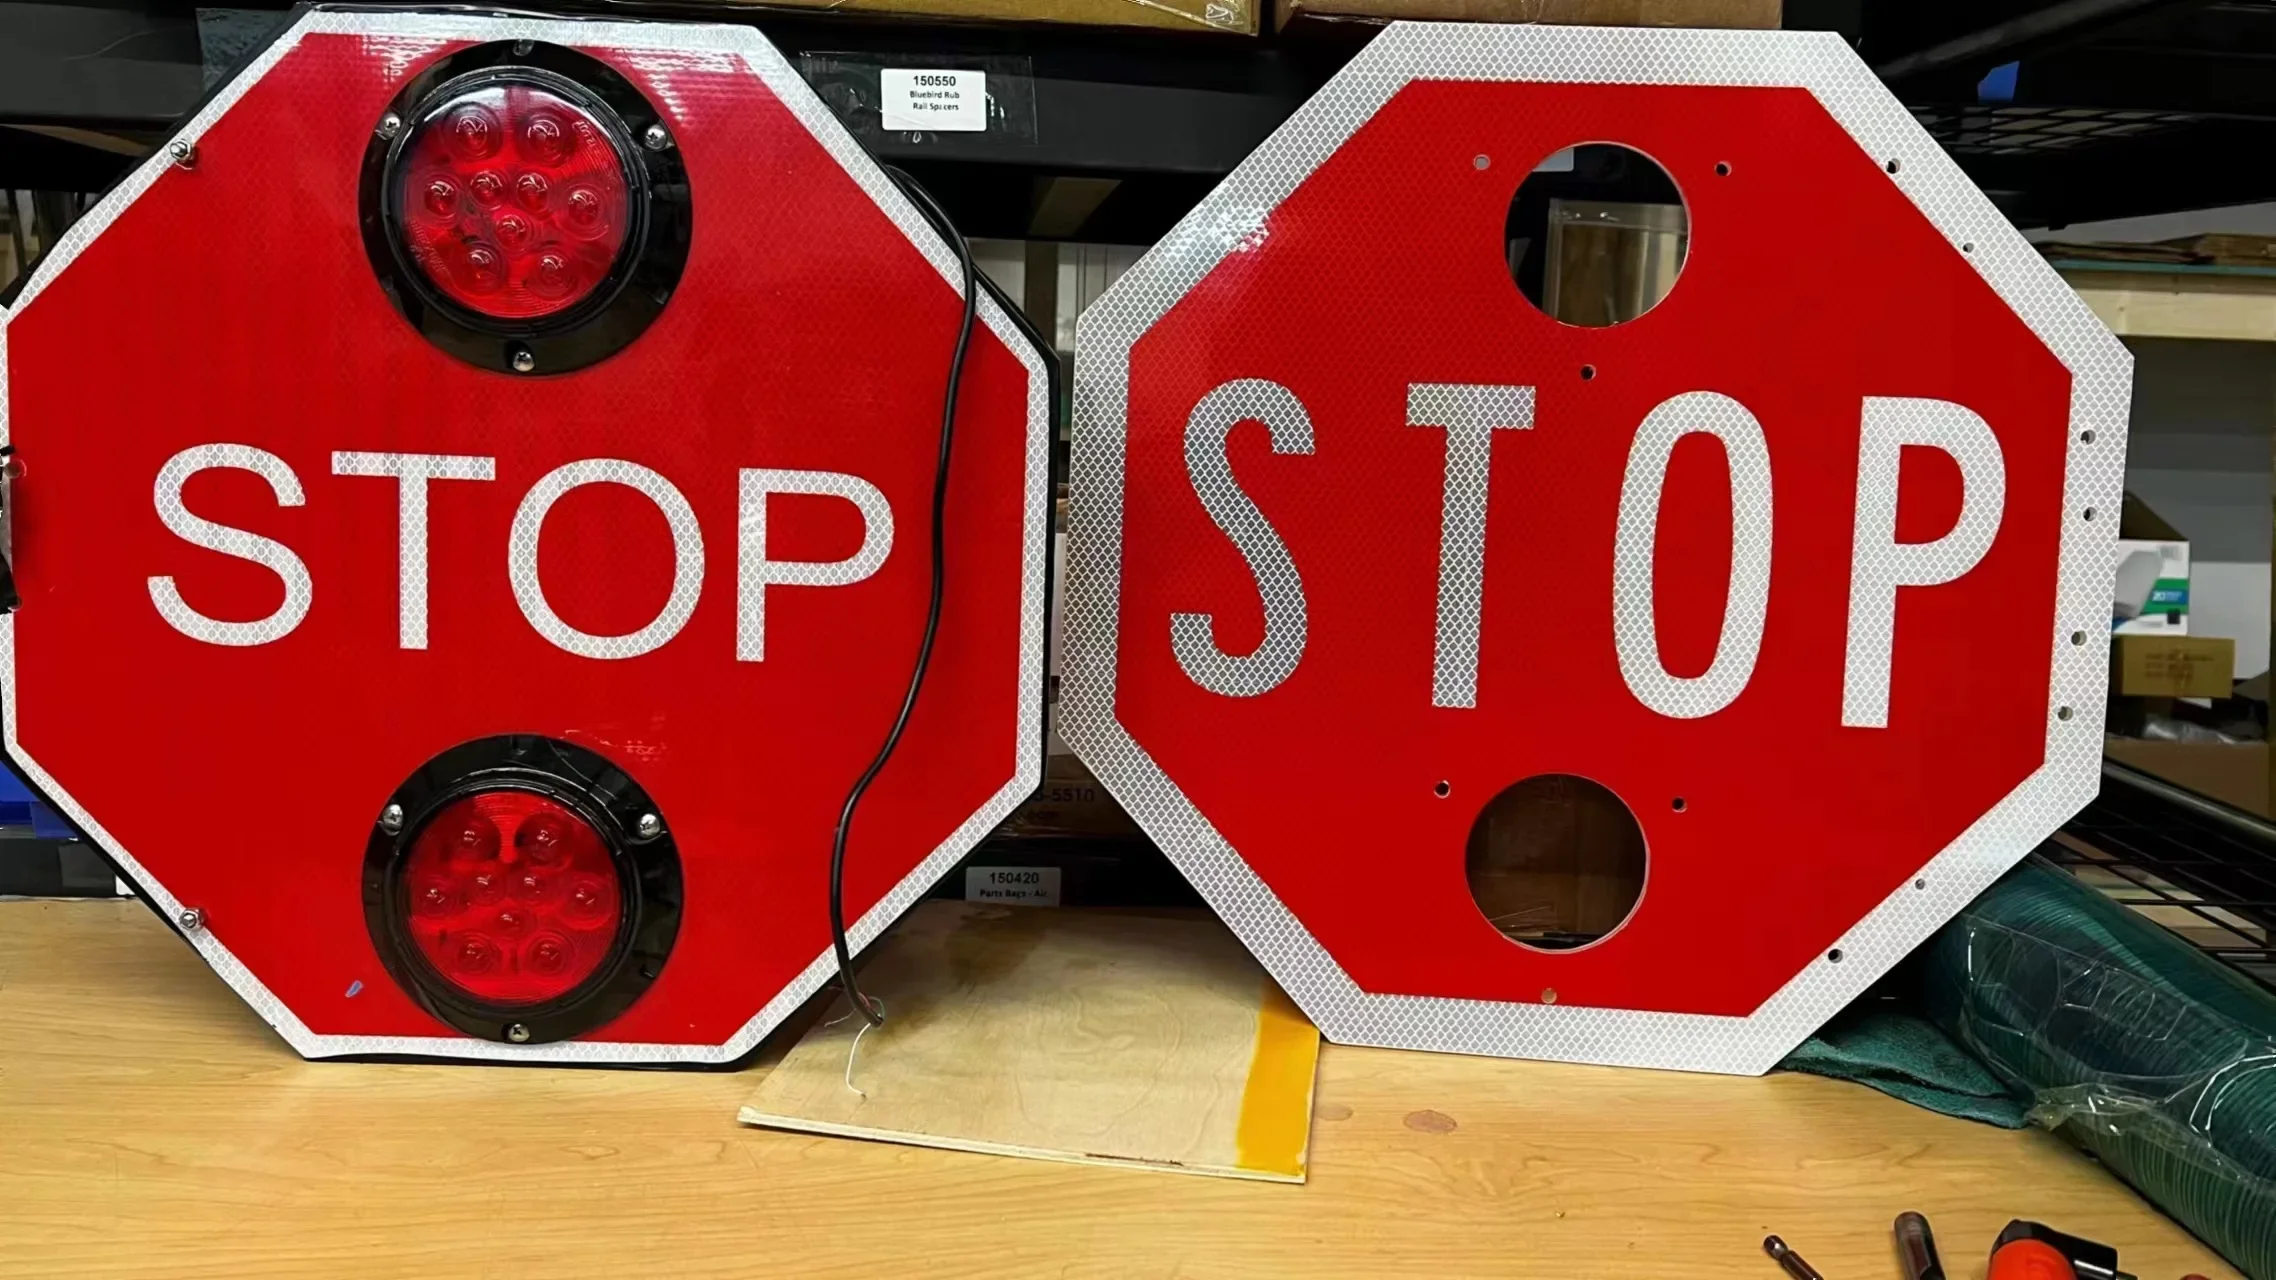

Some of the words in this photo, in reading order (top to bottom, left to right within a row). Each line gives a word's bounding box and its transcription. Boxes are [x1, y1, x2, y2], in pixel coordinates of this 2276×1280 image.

[913, 75, 956, 86] 150550
[909, 90, 942, 99] Bluebird
[944, 91, 960, 99] Rub
[912, 102, 927, 110] Rail
[147, 443, 895, 662] STOP
[1170, 378, 2006, 728] STOP
[989, 872, 1040, 884] 150420
[980, 889, 1002, 897] Parts
[1005, 889, 1026, 899] Bags
[1034, 889, 1047, 897] Air
